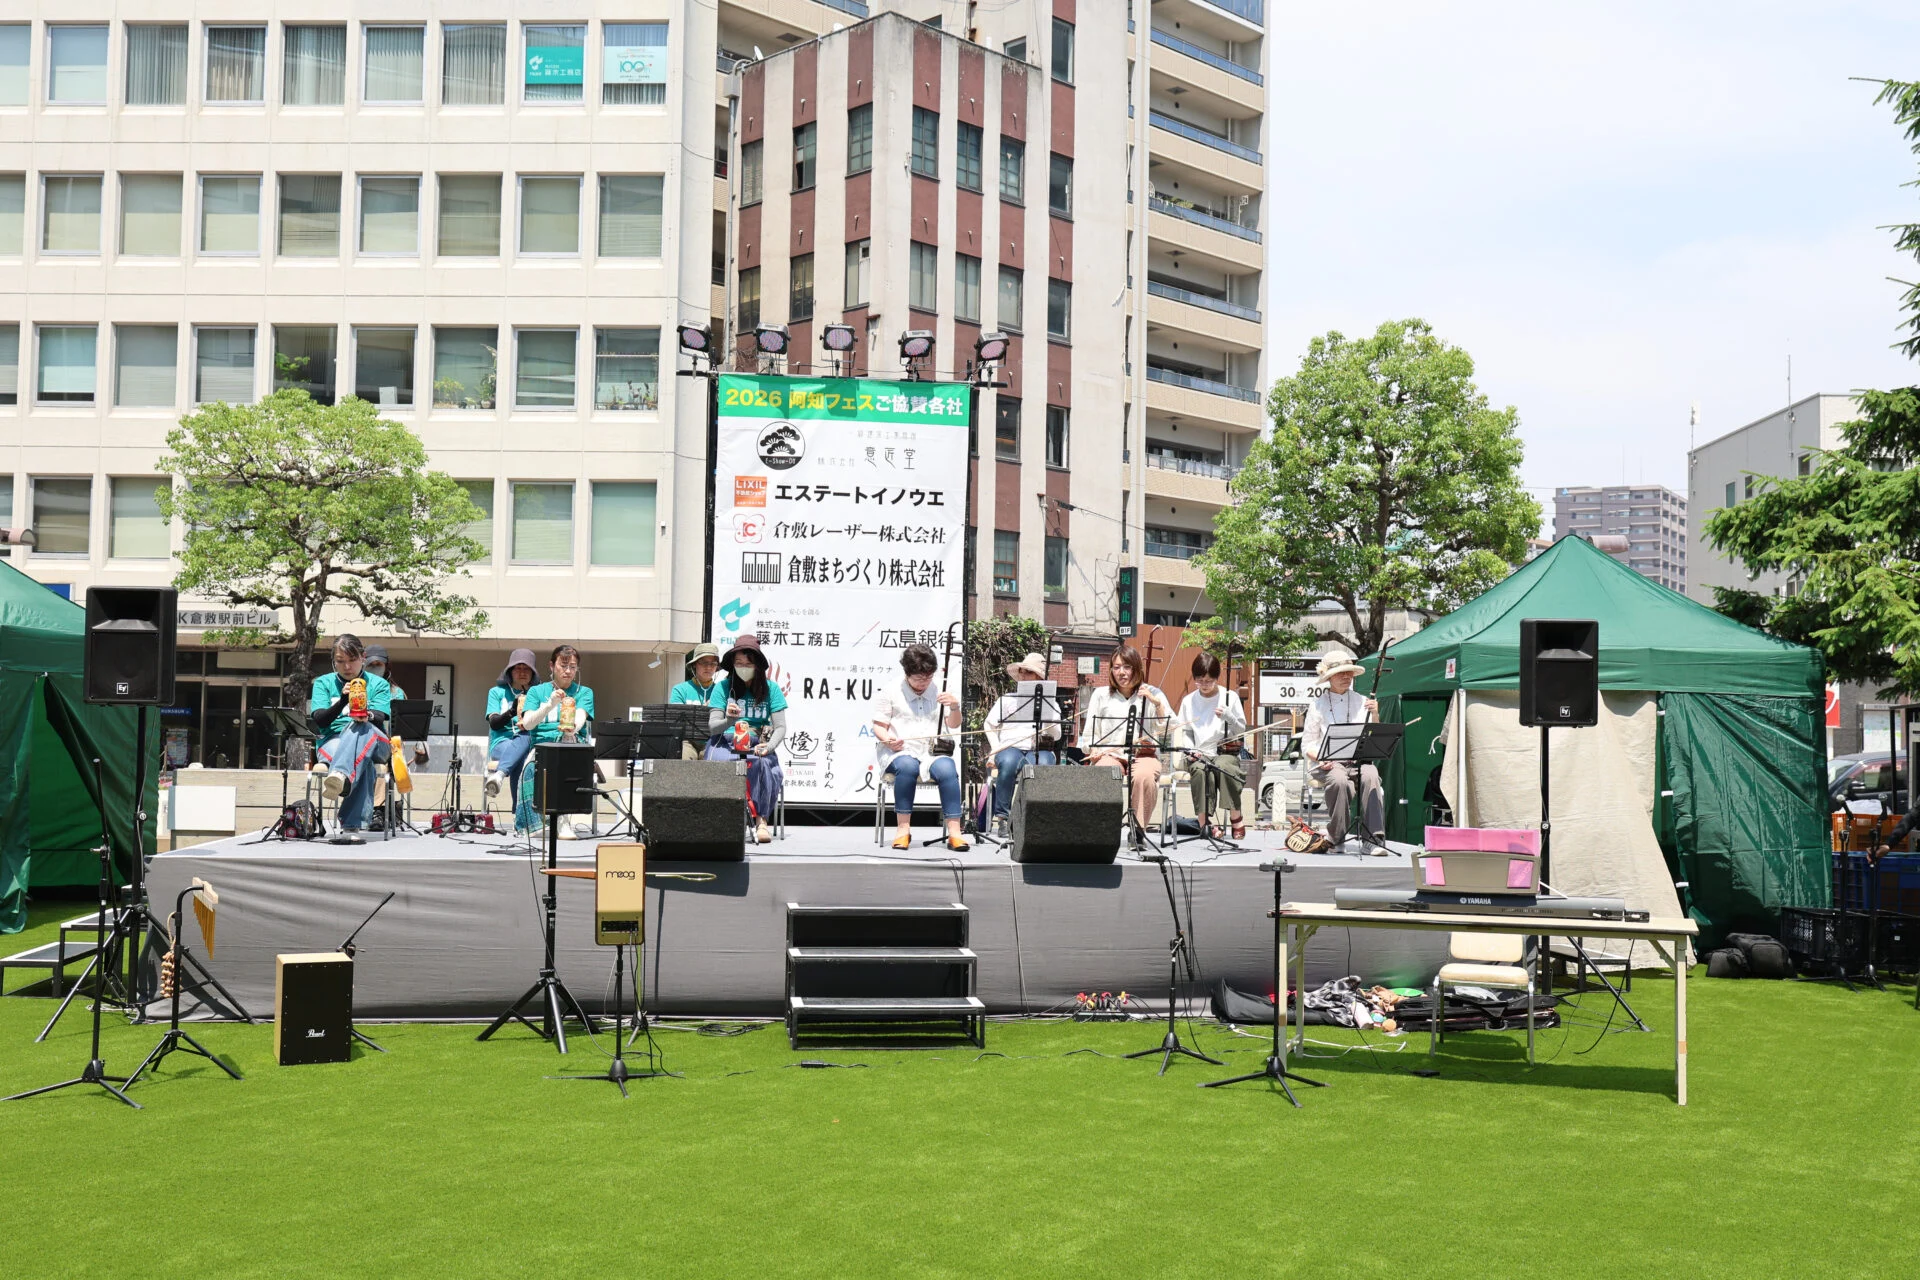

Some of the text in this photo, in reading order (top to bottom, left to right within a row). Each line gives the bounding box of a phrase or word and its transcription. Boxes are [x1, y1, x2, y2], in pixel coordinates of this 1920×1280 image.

[725, 388, 783, 407] 2026
[735, 480, 766, 489] LIXIL
[775, 485, 945, 507] エステートイノウエ
[773, 521, 947, 544] 倉敷レーザー株式会社
[788, 555, 946, 587] 倉敷まちづくり株式会社
[756, 620, 790, 630] 株式会社
[756, 631, 841, 647] 藤木工務店
[1280, 687, 1296, 697] 30
[1467, 897, 1492, 905] YAMAHA
